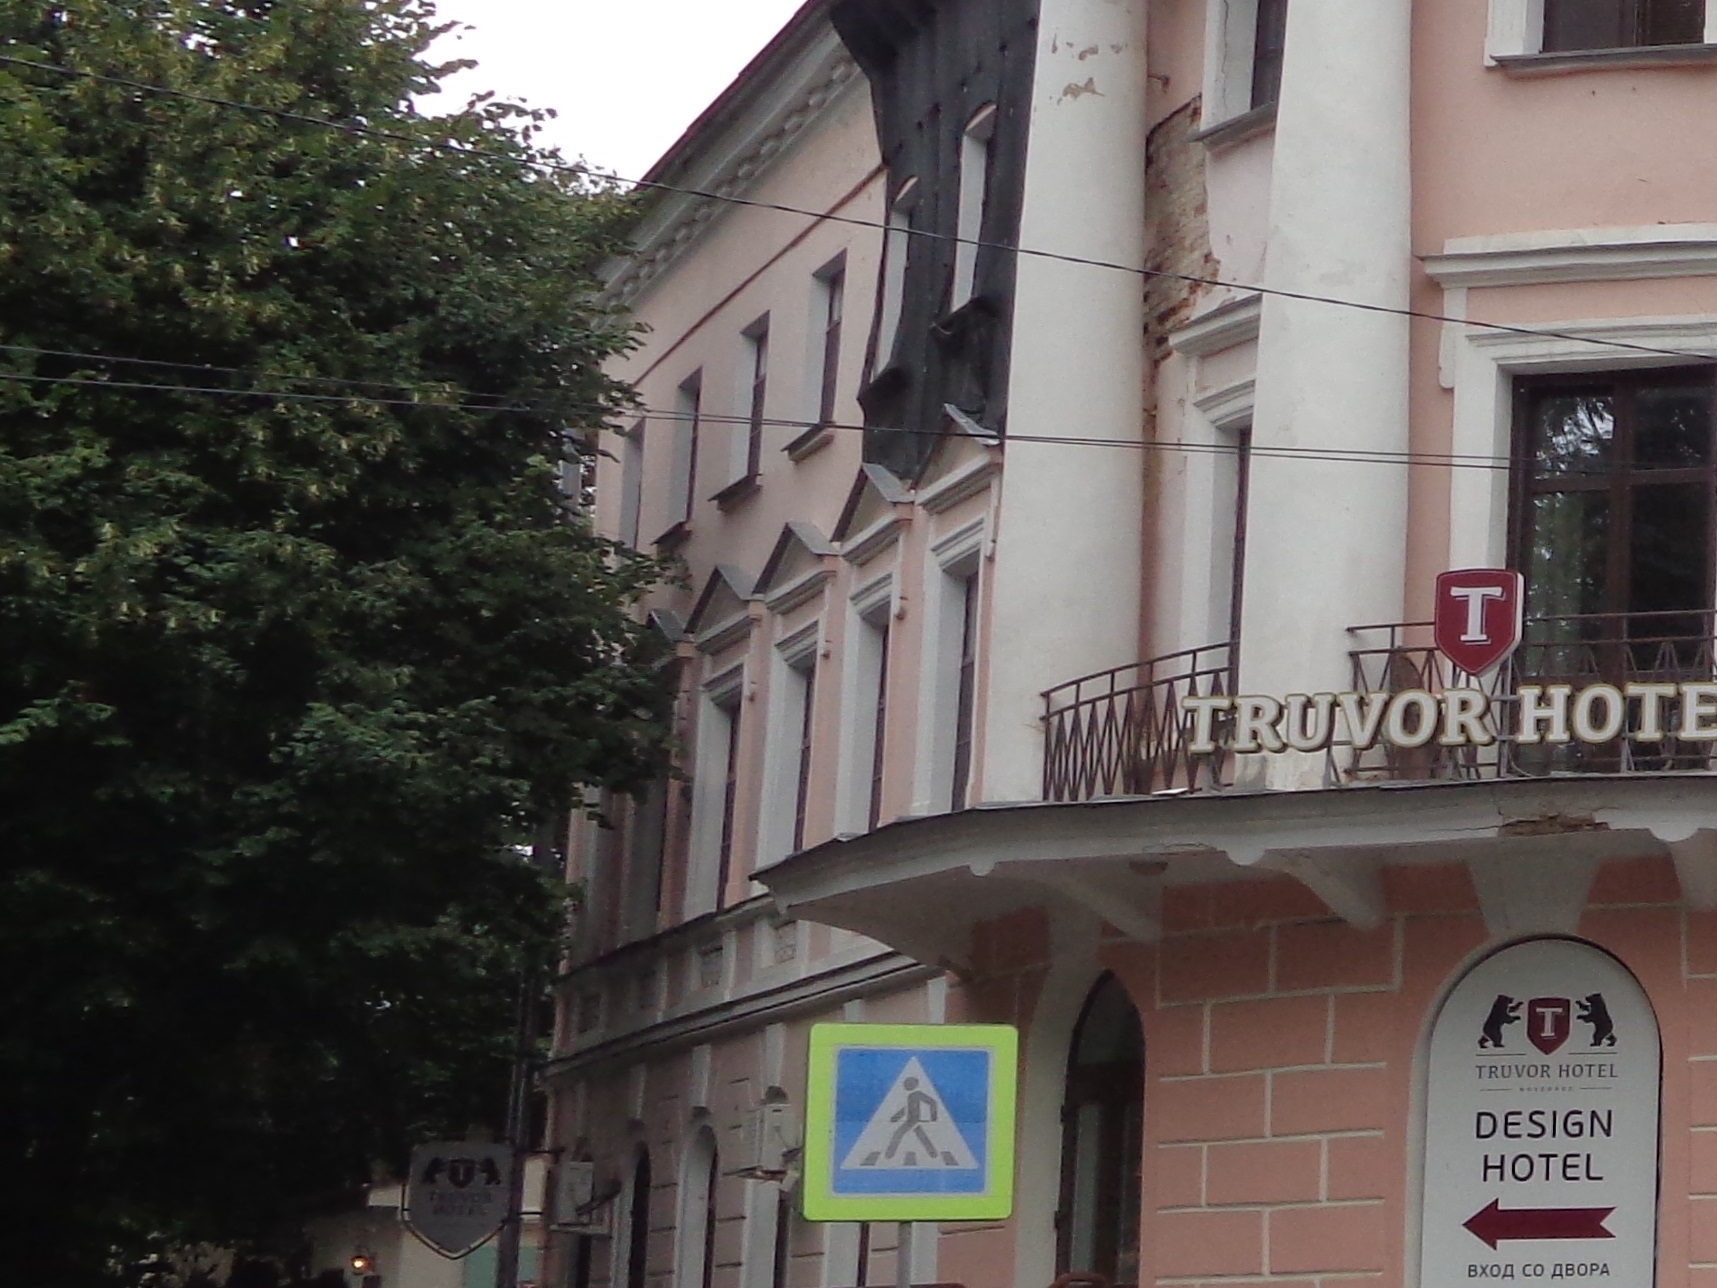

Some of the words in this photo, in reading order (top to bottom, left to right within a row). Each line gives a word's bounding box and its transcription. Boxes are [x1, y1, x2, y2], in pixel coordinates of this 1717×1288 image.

[1449, 585, 1506, 645] T
[1181, 688, 1497, 754] TRUVOR
[1475, 1064, 1551, 1080] TRUVOR
[1558, 1063, 1619, 1079] HOTEL
[1476, 1109, 1613, 1139] DESIGN
[1482, 1153, 1604, 1182] HOTEL
[1467, 1264, 1515, 1280] ВХОД
[1522, 1263, 1545, 1278] СО
[1551, 1263, 1611, 1279] ДВОРА
